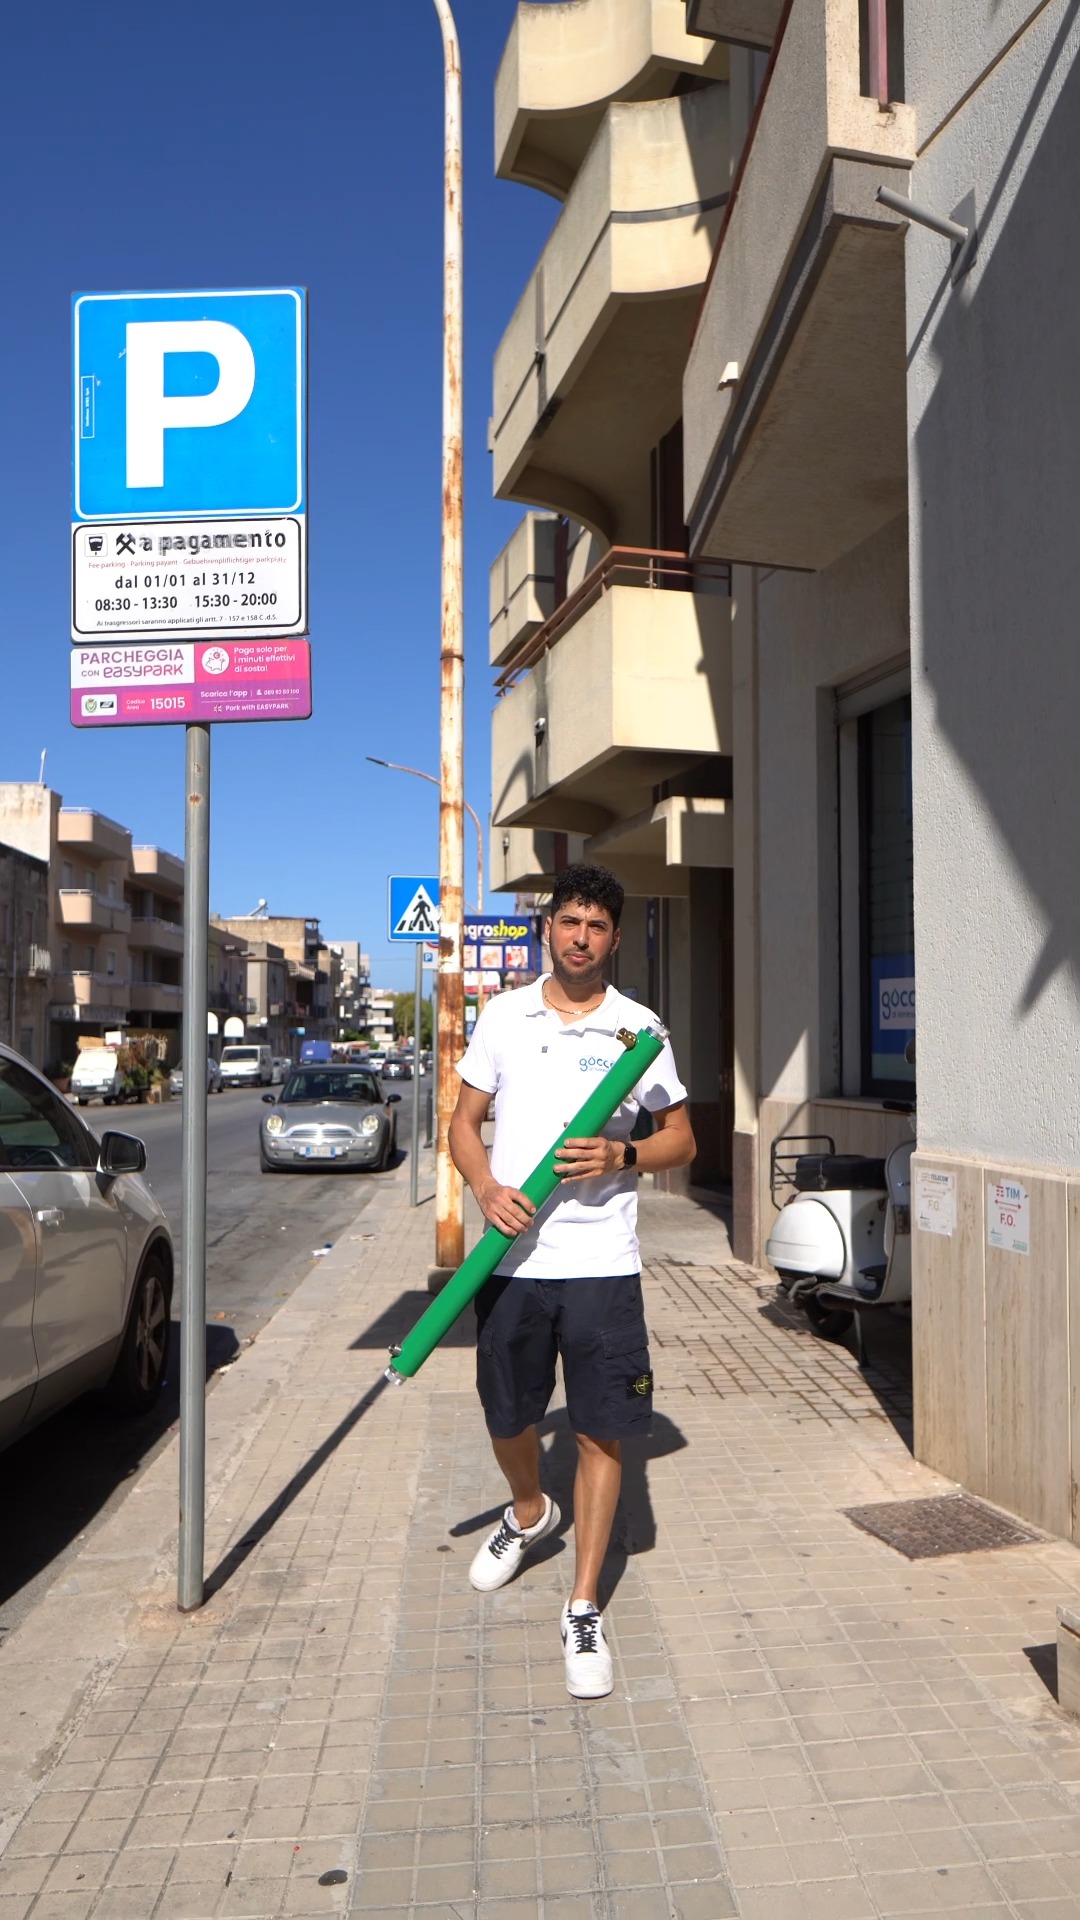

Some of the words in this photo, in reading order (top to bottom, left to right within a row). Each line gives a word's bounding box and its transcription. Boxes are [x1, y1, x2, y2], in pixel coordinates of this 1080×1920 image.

[126, 320, 256, 489] P
[139, 536, 153, 552] a
[159, 531, 286, 556] pagamento
[100, 561, 126, 570] parking
[130, 560, 155, 568] Parking
[155, 560, 178, 568] payant
[115, 575, 138, 589] dal
[144, 574, 185, 588] 01/01
[193, 572, 206, 586] al
[212, 571, 255, 585] 31/12
[95, 598, 131, 611] 08:30
[142, 596, 178, 610] 13:30
[195, 594, 230, 608] 15:30
[241, 592, 277, 606] 20:00
[104, 619, 141, 627] trasgressori
[167, 617, 195, 625] applicati
[195, 616, 204, 624] gli
[80, 648, 184, 665] PARCHEGGIA
[234, 647, 255, 655] Paga
[274, 646, 288, 654] per
[238, 655, 264, 663] minuti
[265, 654, 296, 662] effettivi
[81, 669, 100, 677] CON
[200, 690, 228, 698] Scarica
[229, 690, 248, 698] l'app
[150, 696, 185, 710] 15015
[241, 703, 256, 711] with
[425, 953, 431, 961] P
[881, 988, 915, 1020] gocc
[1005, 1187, 1020, 1200] TIM
[1000, 1213, 1016, 1227] F.O.
